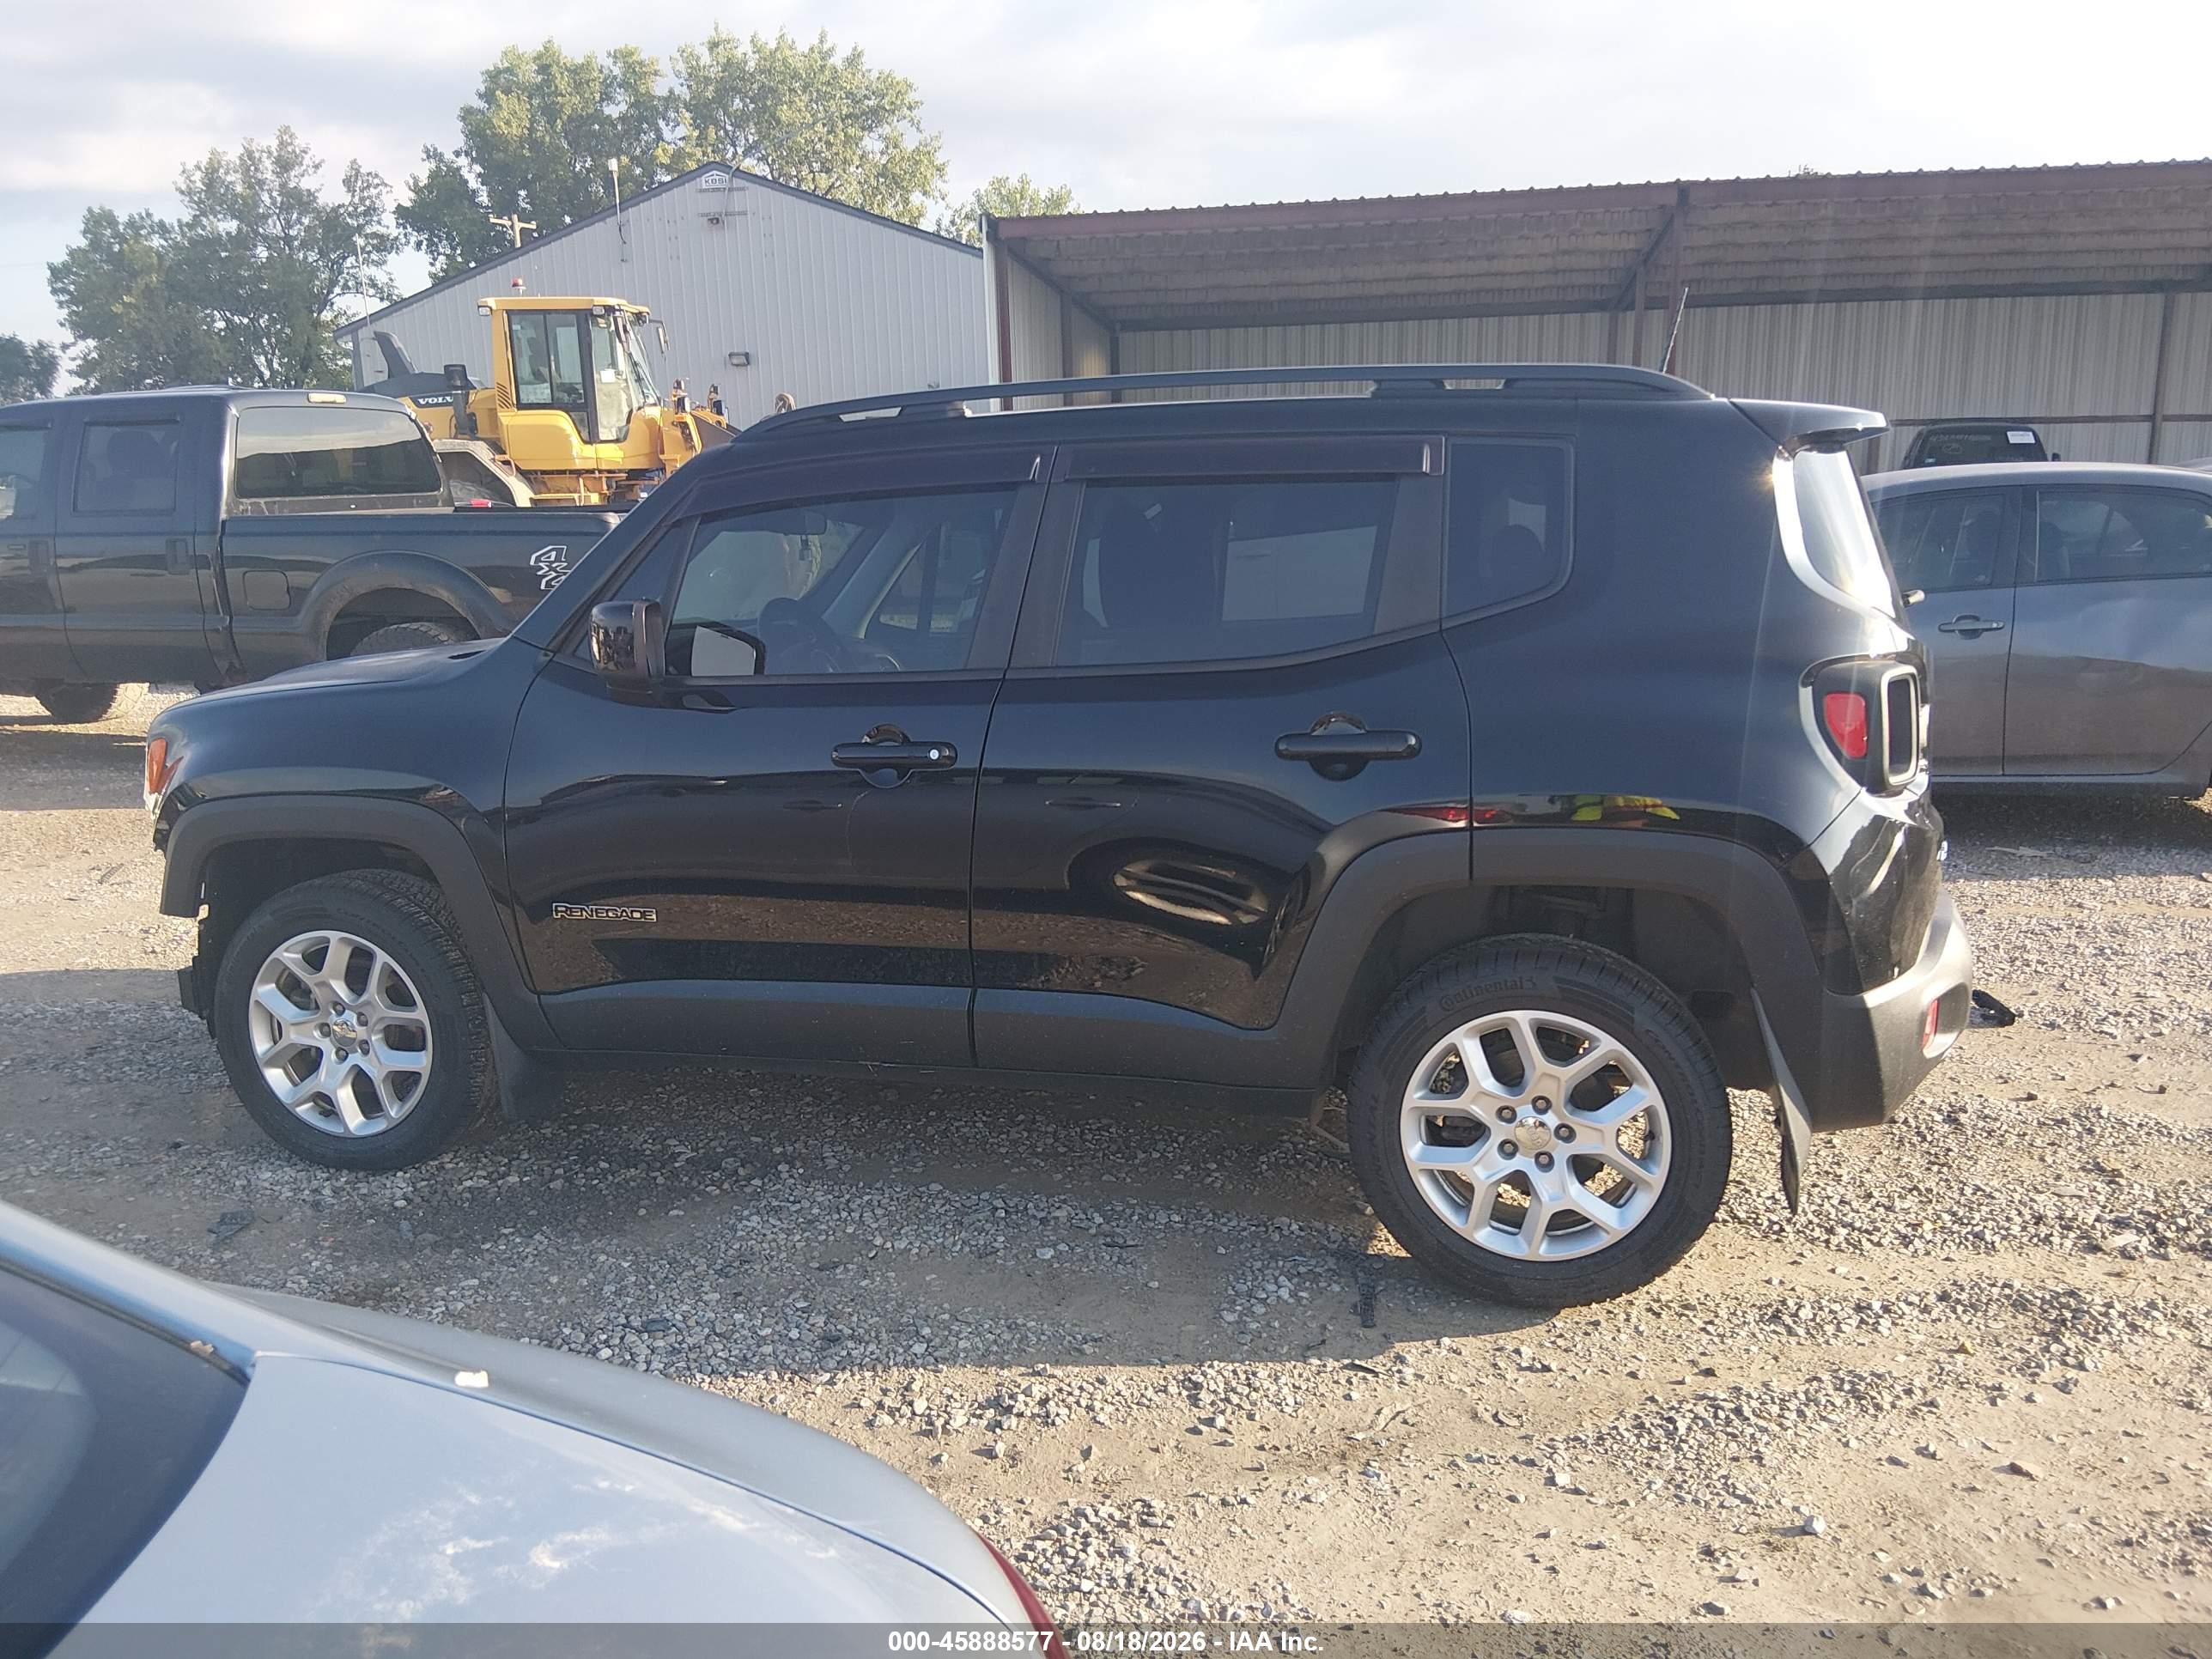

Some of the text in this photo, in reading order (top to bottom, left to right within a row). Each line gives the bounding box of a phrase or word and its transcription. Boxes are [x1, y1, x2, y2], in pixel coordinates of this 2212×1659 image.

[417, 396, 454, 405] VOLV
[552, 902, 658, 922] RENEGADE
[1438, 975, 1524, 1012] Continental
